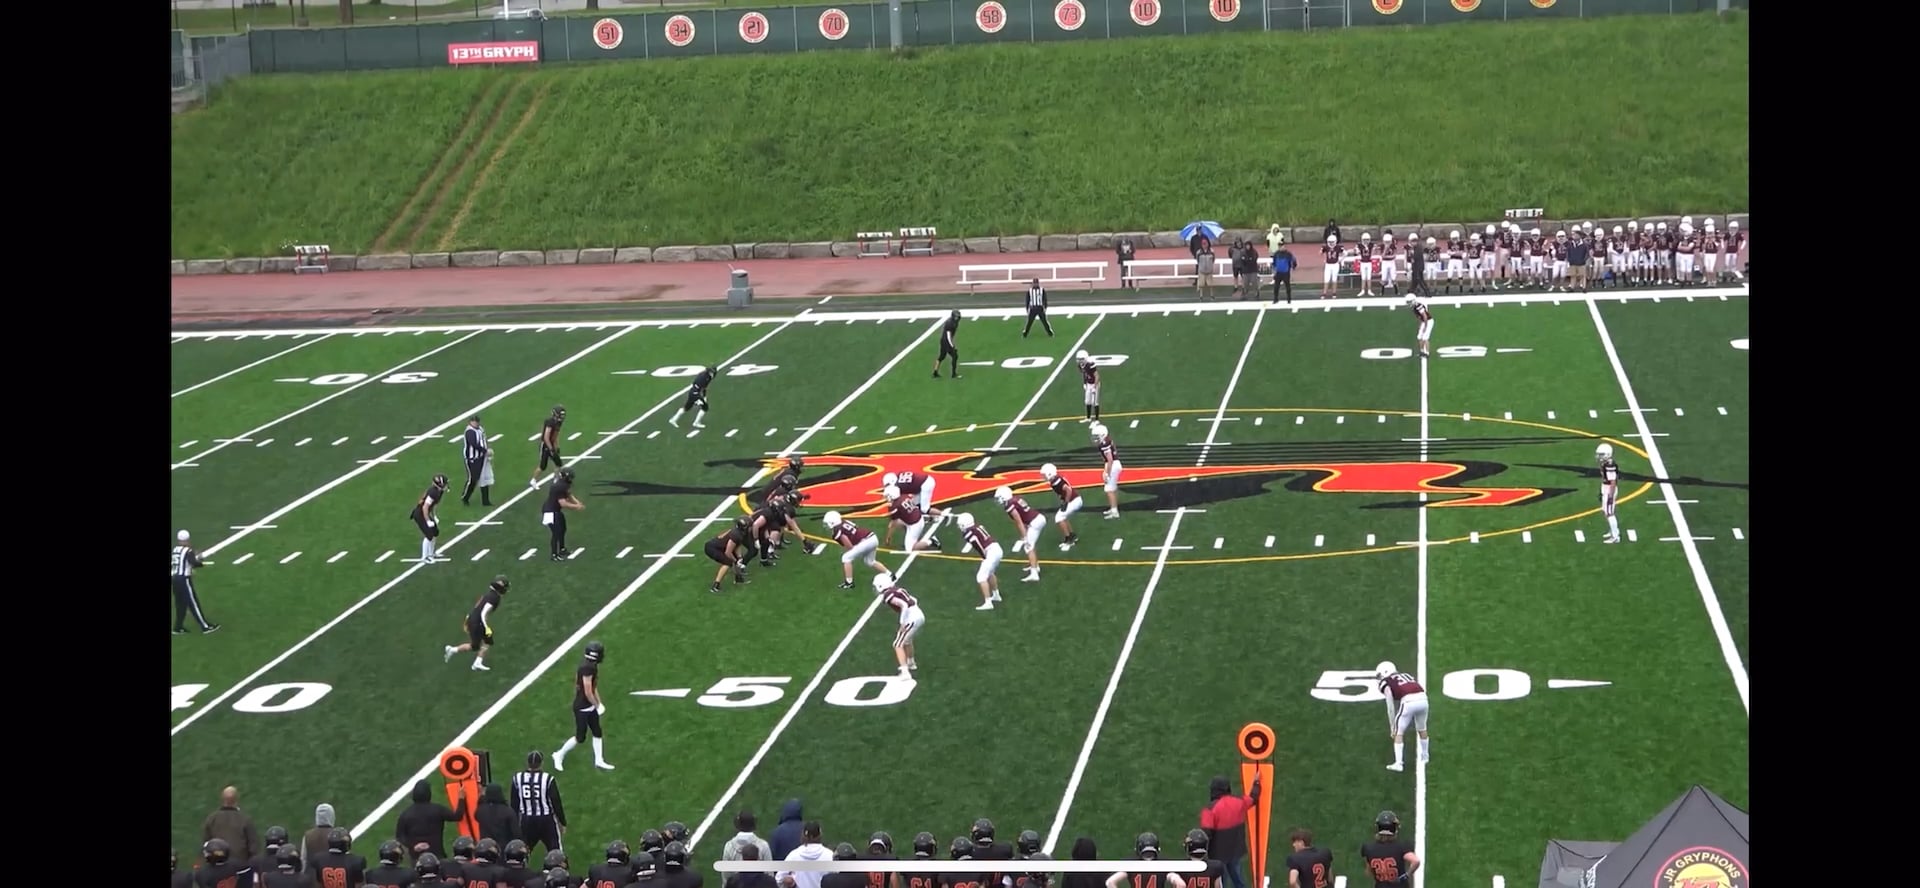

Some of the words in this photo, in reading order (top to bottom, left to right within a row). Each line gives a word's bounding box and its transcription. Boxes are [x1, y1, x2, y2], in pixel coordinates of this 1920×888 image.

[1062, 7, 1078, 21] 73
[1138, 3, 1153, 16] 10
[826, 17, 842, 31] 70
[983, 10, 1000, 24] 58
[601, 27, 615, 40] 51
[672, 24, 688, 37] 34
[747, 21, 761, 34] 21
[483, 45, 534, 58] GRYPH
[697, 676, 917, 707] 50
[522, 784, 540, 798] 65
[1370, 857, 1398, 882] 36
[1663, 868, 1677, 882] JR
[1675, 852, 1741, 879] GRYPHONS
[322, 867, 347, 888] 68
[1312, 863, 1328, 888] 2
